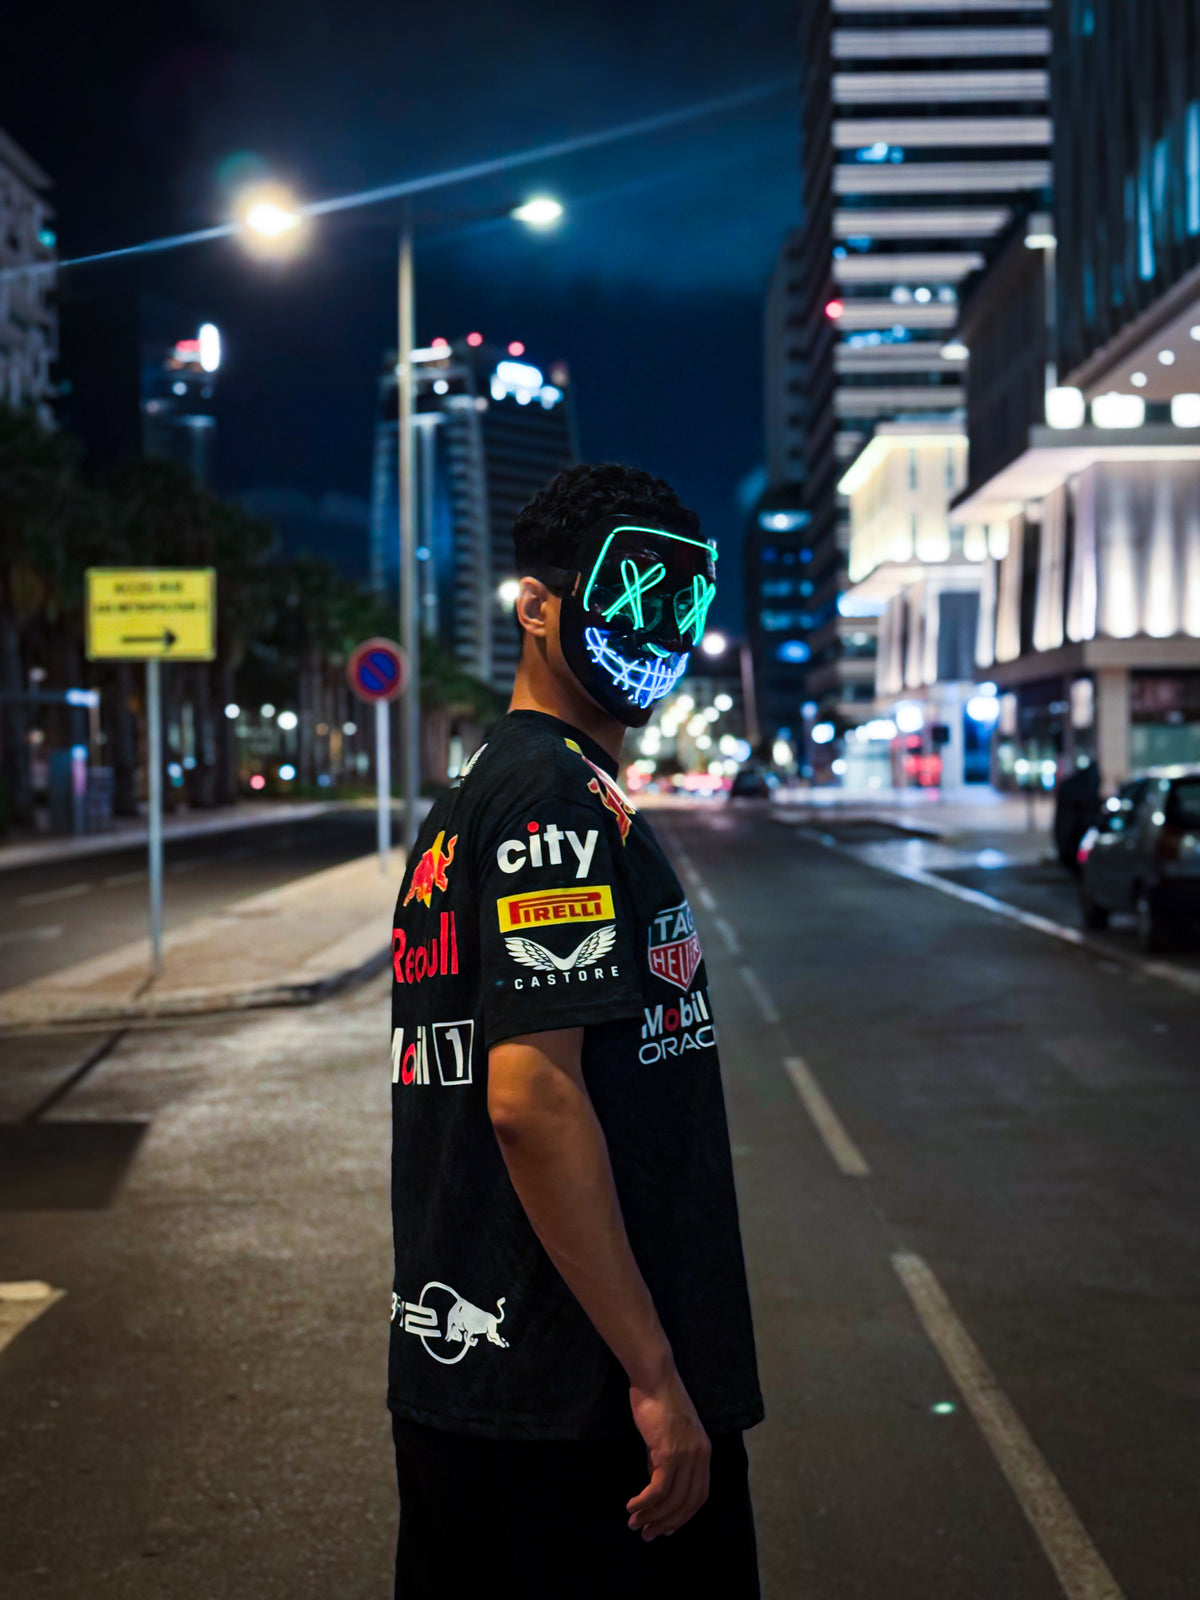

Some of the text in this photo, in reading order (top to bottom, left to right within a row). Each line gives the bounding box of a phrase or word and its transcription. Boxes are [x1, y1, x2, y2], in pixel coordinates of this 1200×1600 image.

[497, 821, 599, 878] city
[508, 892, 602, 925] PIRELLI
[514, 965, 620, 990] CASTORE
[641, 991, 709, 1029] Mobil
[445, 1028, 464, 1078] 1
